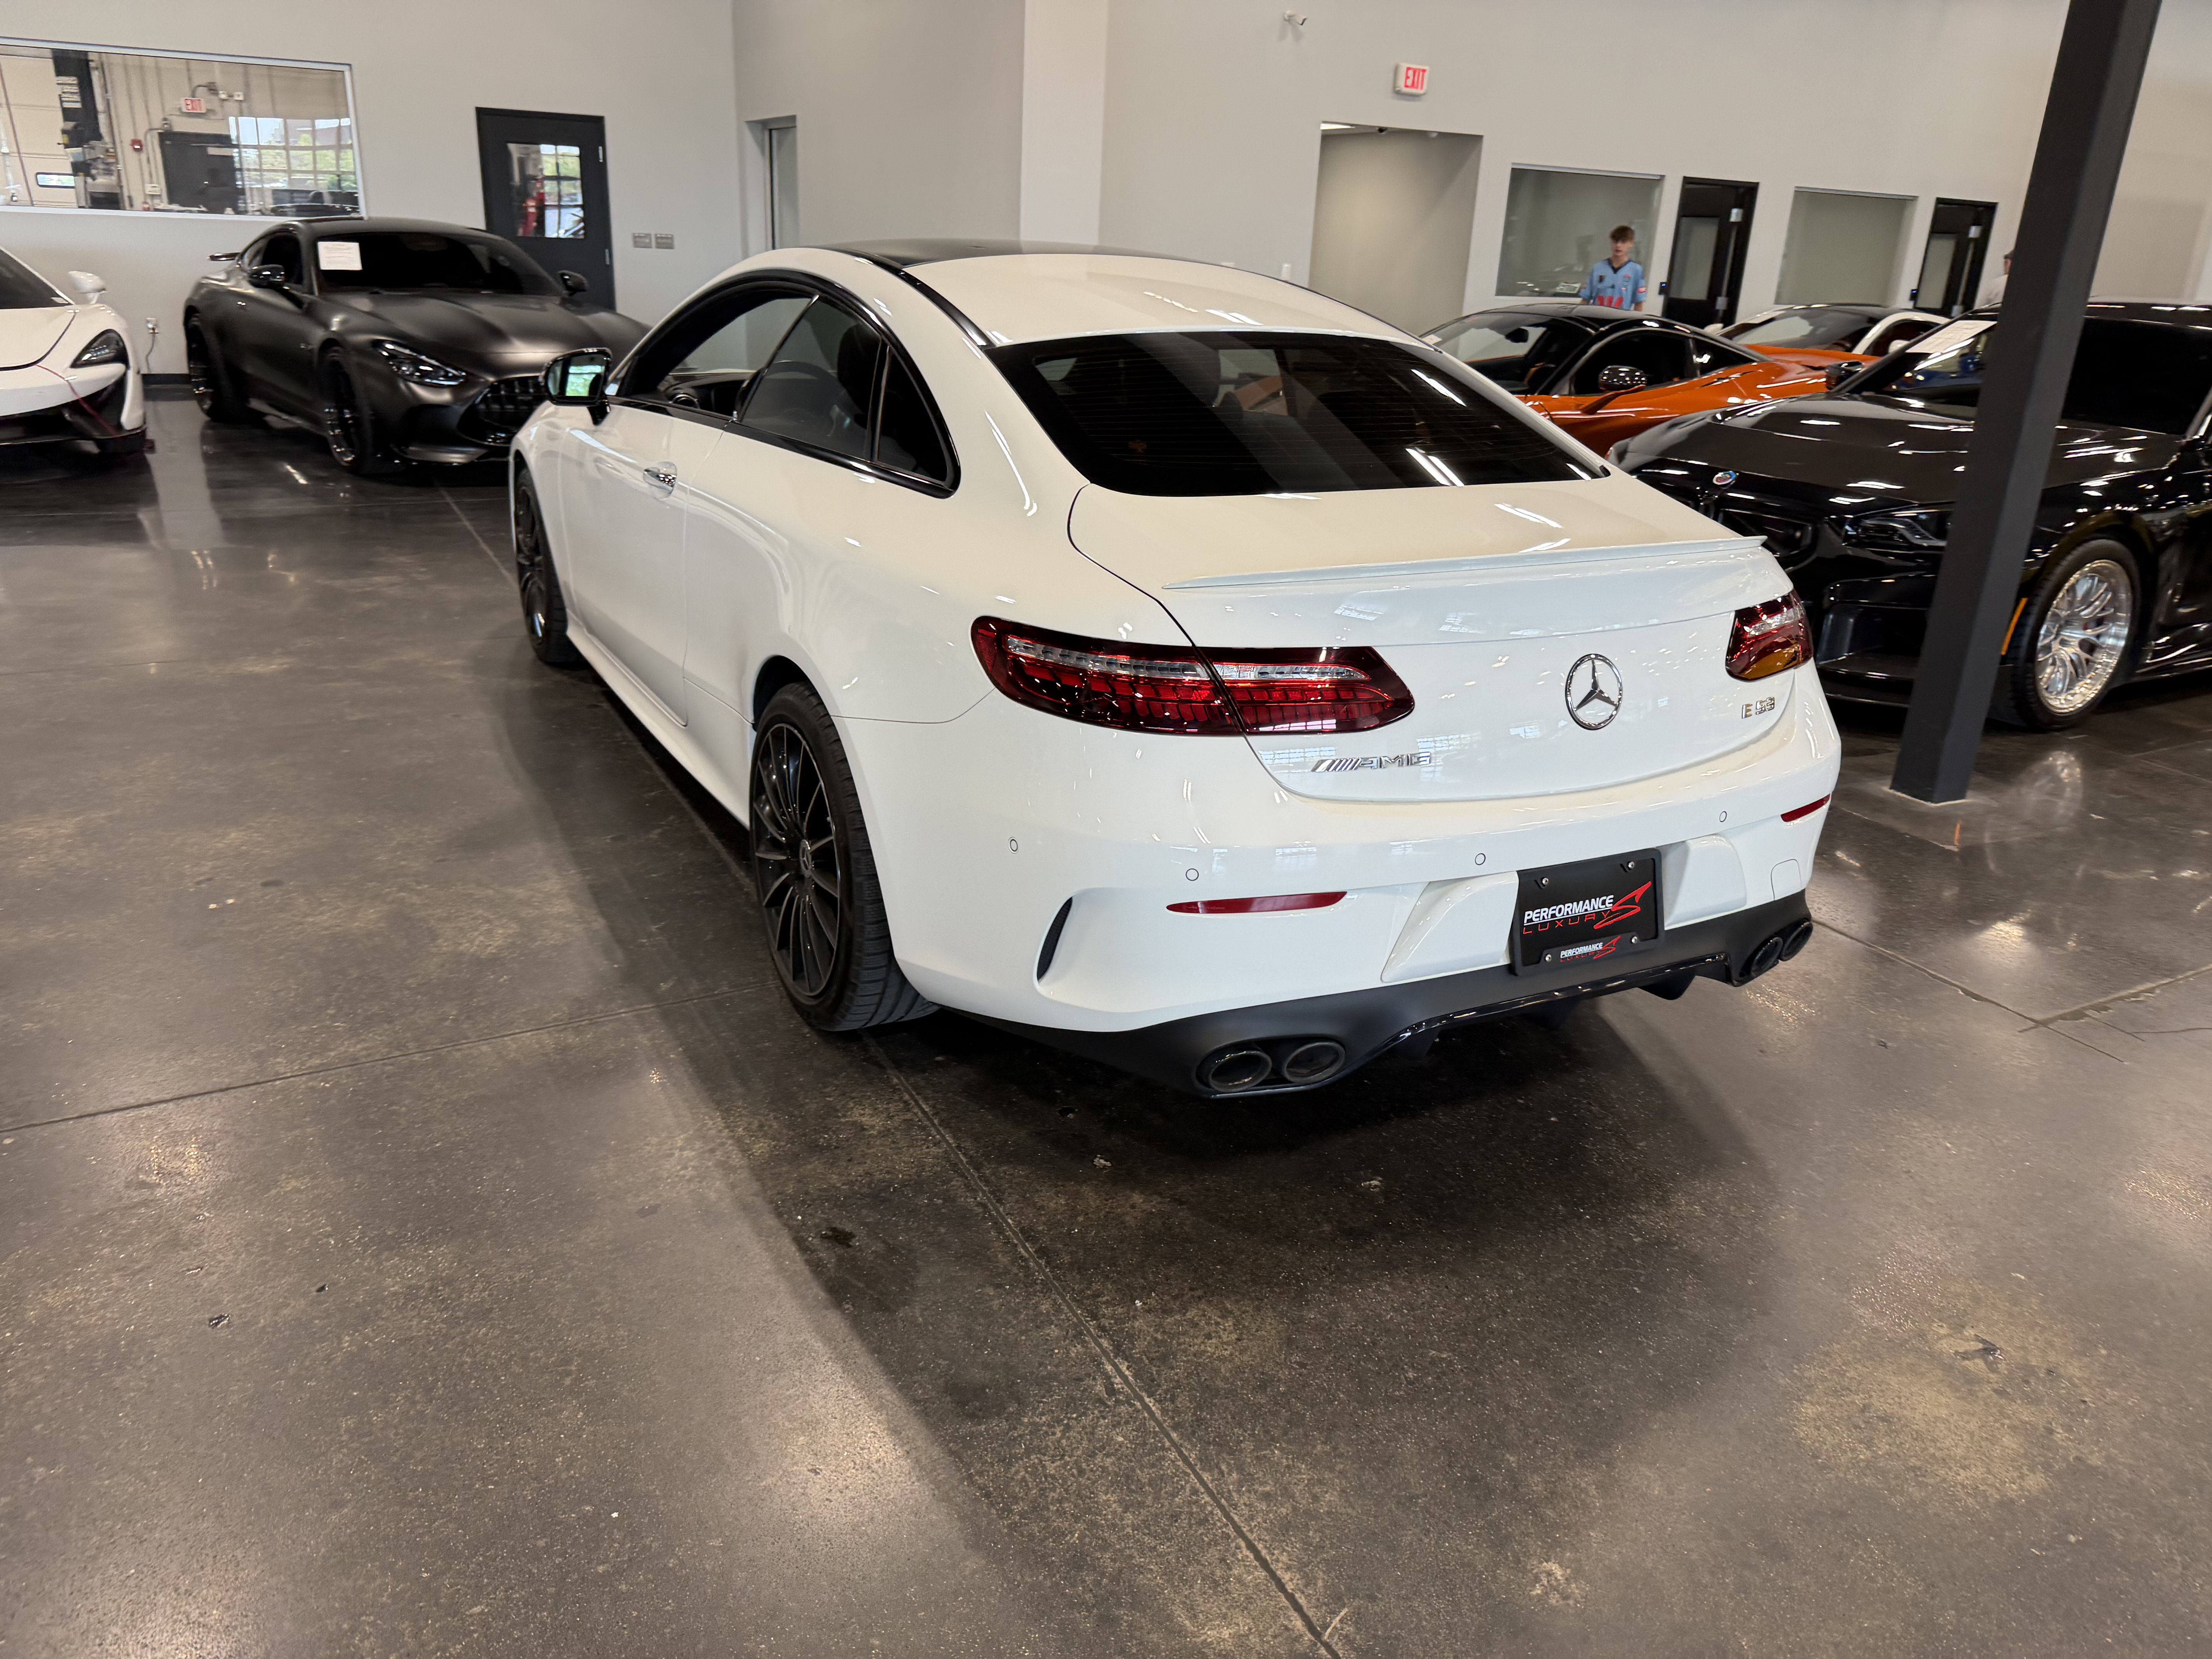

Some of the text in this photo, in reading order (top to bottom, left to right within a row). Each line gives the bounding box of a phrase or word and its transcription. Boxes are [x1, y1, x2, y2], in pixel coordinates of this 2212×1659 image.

[1404, 67, 1427, 90] EXIT
[1741, 703, 1753, 719] E
[1353, 751, 1431, 770] AMG
[1524, 895, 1614, 924] PERFORMANCE
[1523, 910, 1610, 934] LUXURY
[1560, 942, 1603, 958] PERFORMANCE
